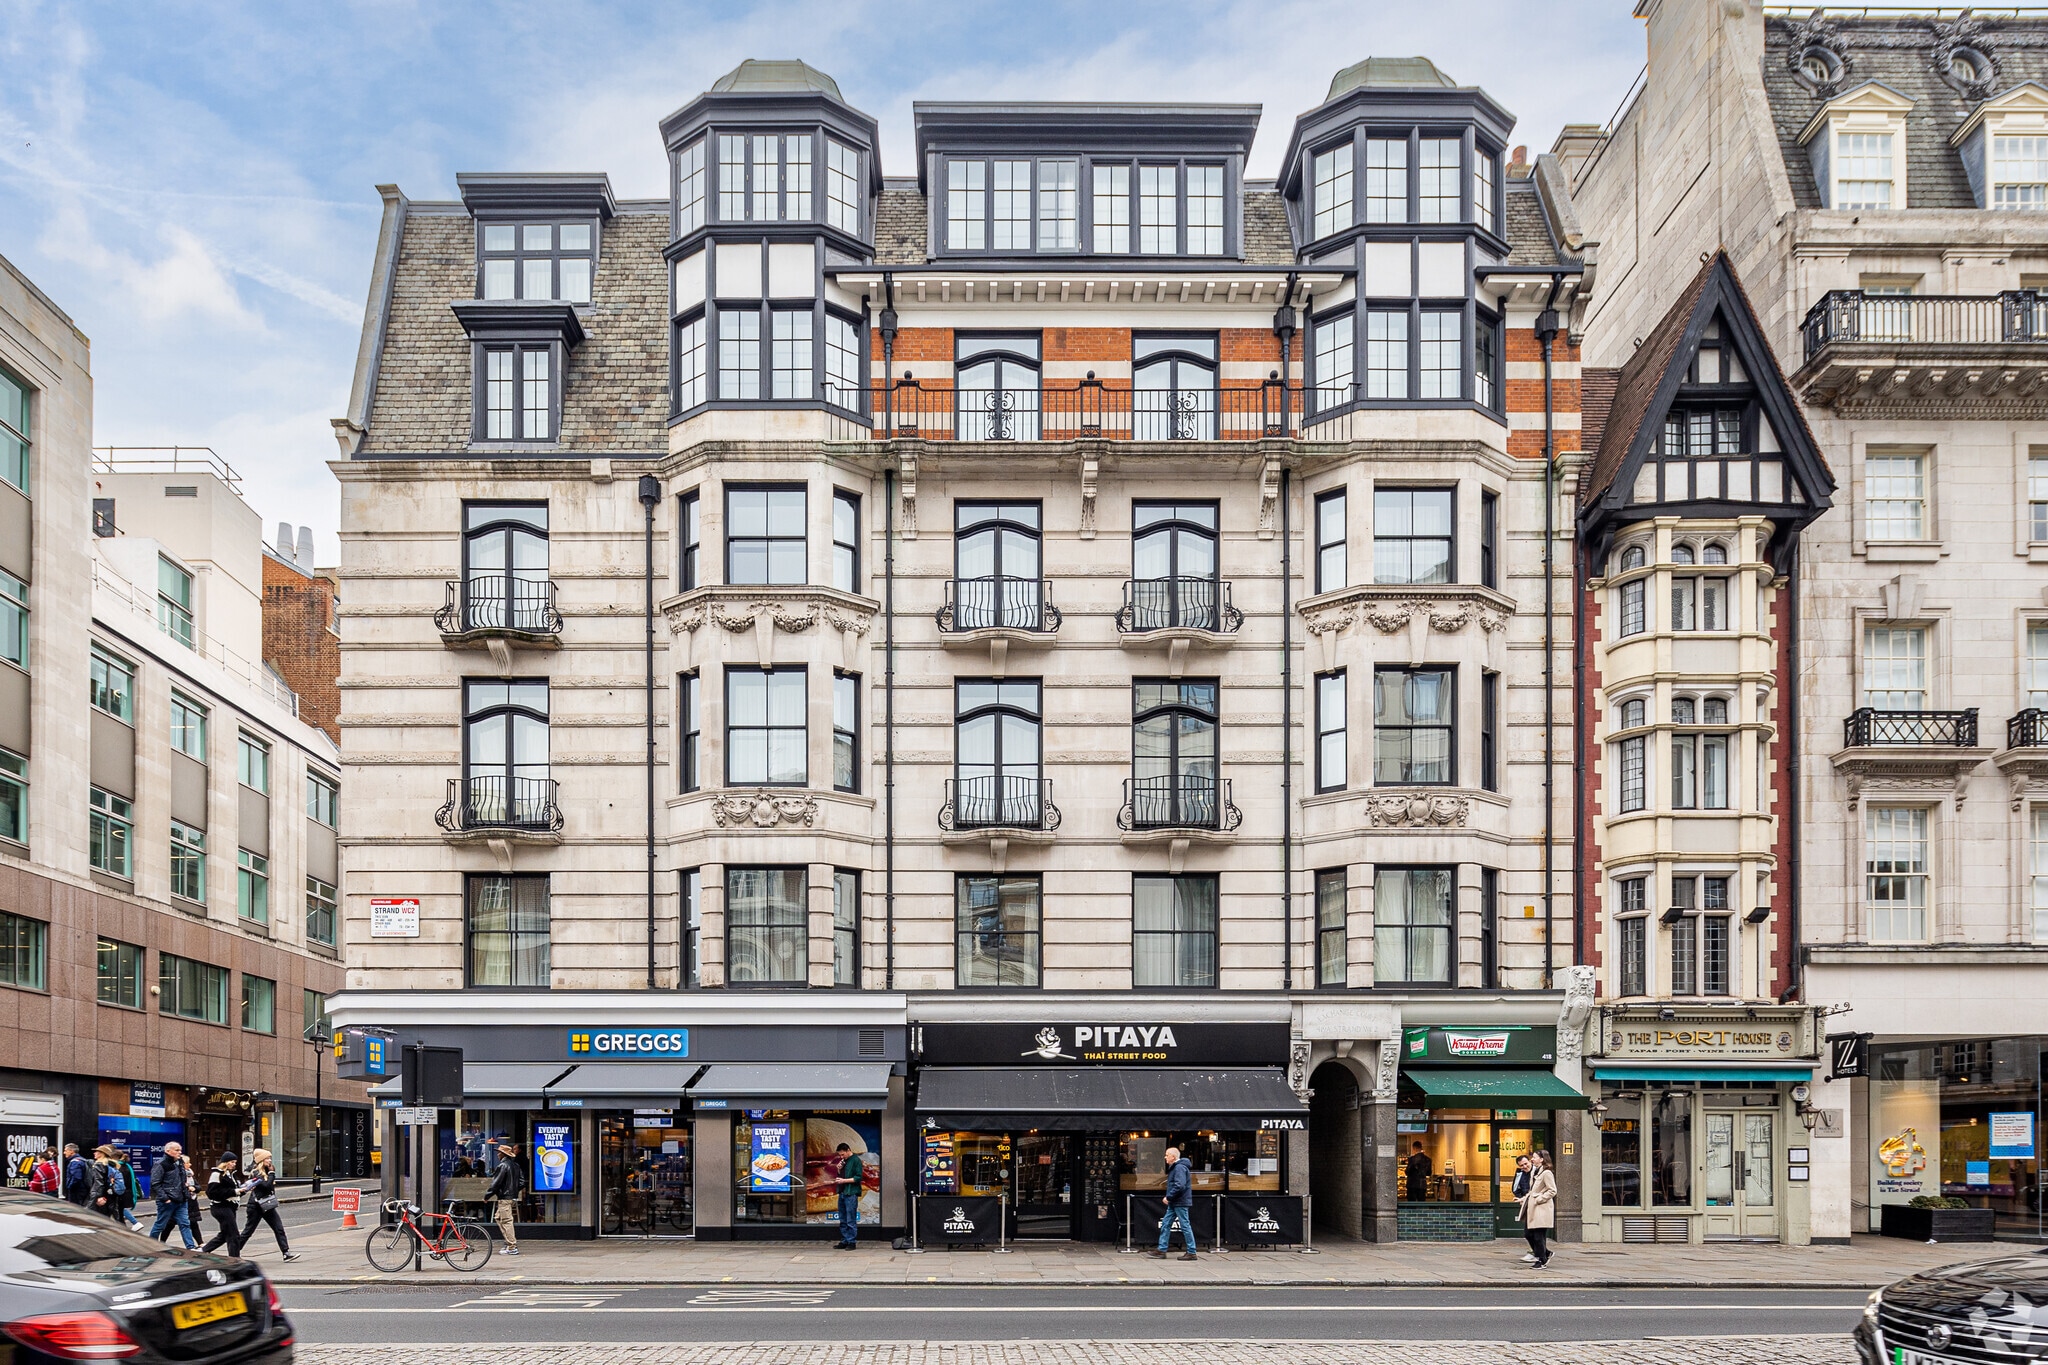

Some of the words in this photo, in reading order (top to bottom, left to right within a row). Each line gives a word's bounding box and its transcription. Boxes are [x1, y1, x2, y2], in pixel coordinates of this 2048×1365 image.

[1333, 1025, 1362, 1033] STRAND
[1075, 1026, 1178, 1047] PITAYA
[1627, 1032, 1651, 1045] THE
[1654, 1030, 1731, 1046] PORT
[1733, 1032, 1772, 1045] HOUSE
[594, 1033, 682, 1051] GREGGS
[1452, 1038, 1480, 1050] Krispy
[1479, 1038, 1505, 1049] Kreme
[1837, 1039, 1858, 1068] Z
[1837, 1067, 1858, 1075] HOTELS
[1261, 1119, 1304, 1129] PITAYA
[356, 1111, 364, 1153] BEDFORD
[538, 1126, 569, 1134] EVERYDAY
[755, 1128, 786, 1136] EVERYDAY
[544, 1133, 563, 1141] TASTY
[7, 1134, 48, 1153] COMING
[1505, 1141, 1526, 1151] GLAZED
[356, 1156, 364, 1176] ONE
[1877, 1179, 1902, 1187] Building
[1903, 1179, 1923, 1187] society
[943, 1222, 975, 1230] PITAYA
[1248, 1222, 1280, 1230] PITAYA
